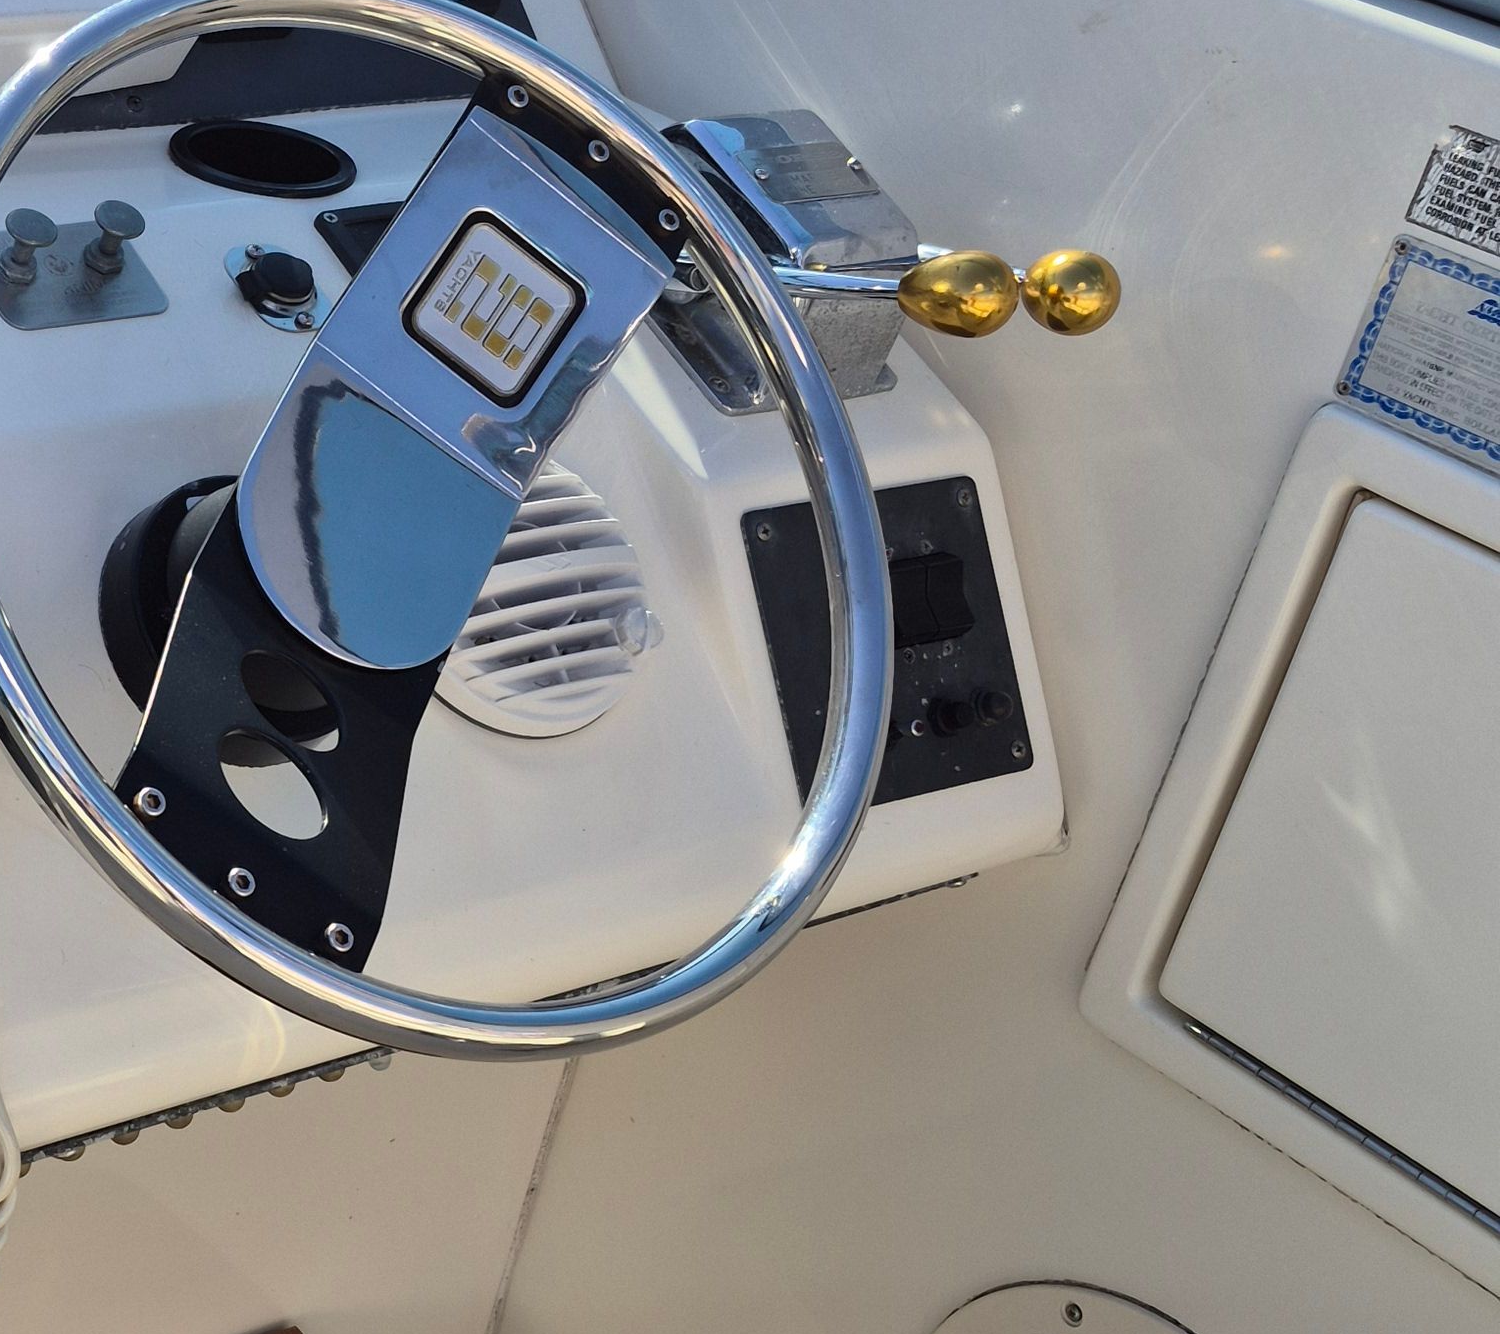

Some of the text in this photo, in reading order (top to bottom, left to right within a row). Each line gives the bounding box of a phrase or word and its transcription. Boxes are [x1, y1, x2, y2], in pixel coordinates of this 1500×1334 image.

[1440, 174, 1466, 189] FUELS
[1430, 195, 1472, 217] EXAMINE
[434, 249, 482, 313] YACHTS
